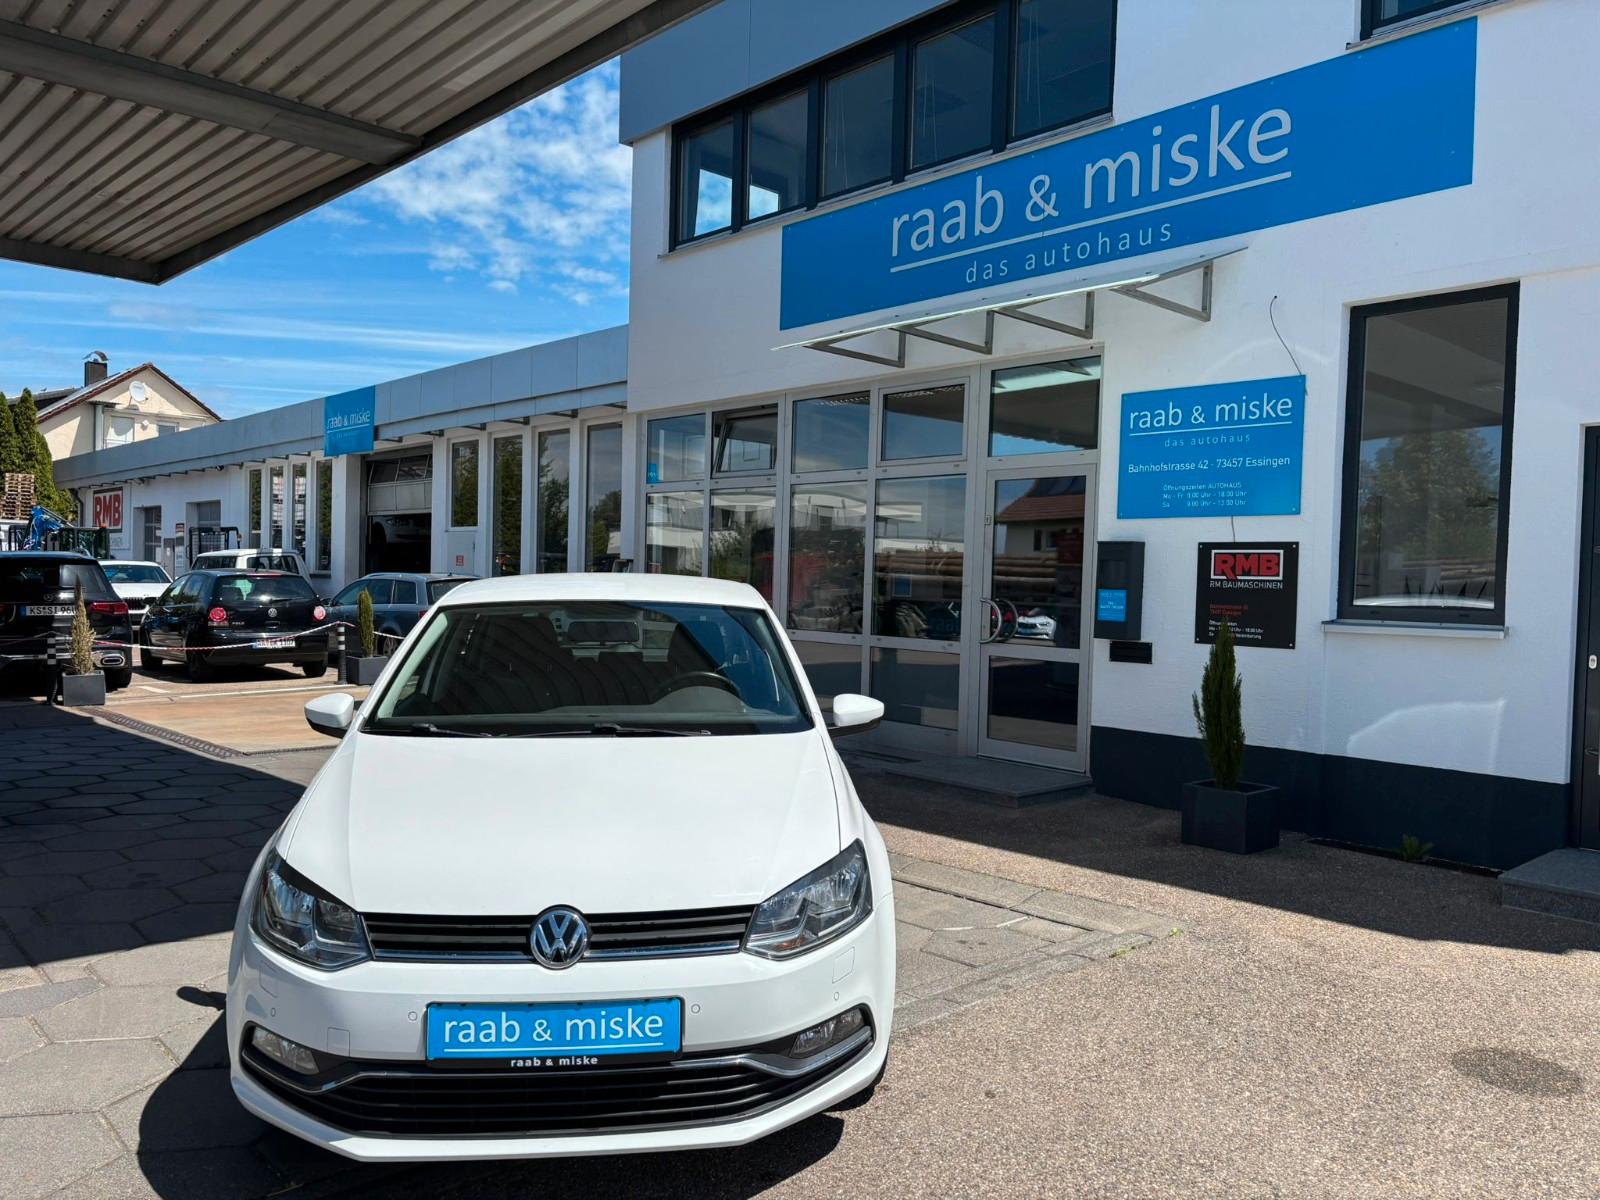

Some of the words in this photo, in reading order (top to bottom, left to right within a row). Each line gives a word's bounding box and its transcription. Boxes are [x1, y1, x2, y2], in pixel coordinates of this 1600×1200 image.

[891, 176, 1004, 257] raab
[1024, 174, 1059, 223] &
[1083, 104, 1292, 209] miske
[965, 258, 1009, 284] das
[1024, 222, 1173, 271] autohaus
[327, 411, 342, 429] raab
[350, 408, 371, 425] miske
[1129, 401, 1182, 430] raab
[1191, 405, 1206, 424] &
[1215, 392, 1293, 422] miske
[1164, 437, 1184, 447] das
[1190, 433, 1251, 446] autohaus
[1128, 462, 1196, 473] Bahnhofstrasse
[1197, 459, 1209, 469] 42
[1216, 457, 1244, 469] 73457
[1245, 456, 1291, 468] Essingen
[95, 494, 120, 528] RMB
[1215, 553, 1280, 581] RMB
[1209, 580, 1221, 588] RM
[1222, 581, 1283, 590] BAUMASCHINEN
[444, 1011, 521, 1043] raab
[532, 1019, 553, 1042] &
[566, 1008, 664, 1041] miske
[511, 1057, 541, 1067] raab
[545, 1058, 554, 1066] &
[559, 1055, 599, 1066] miske
